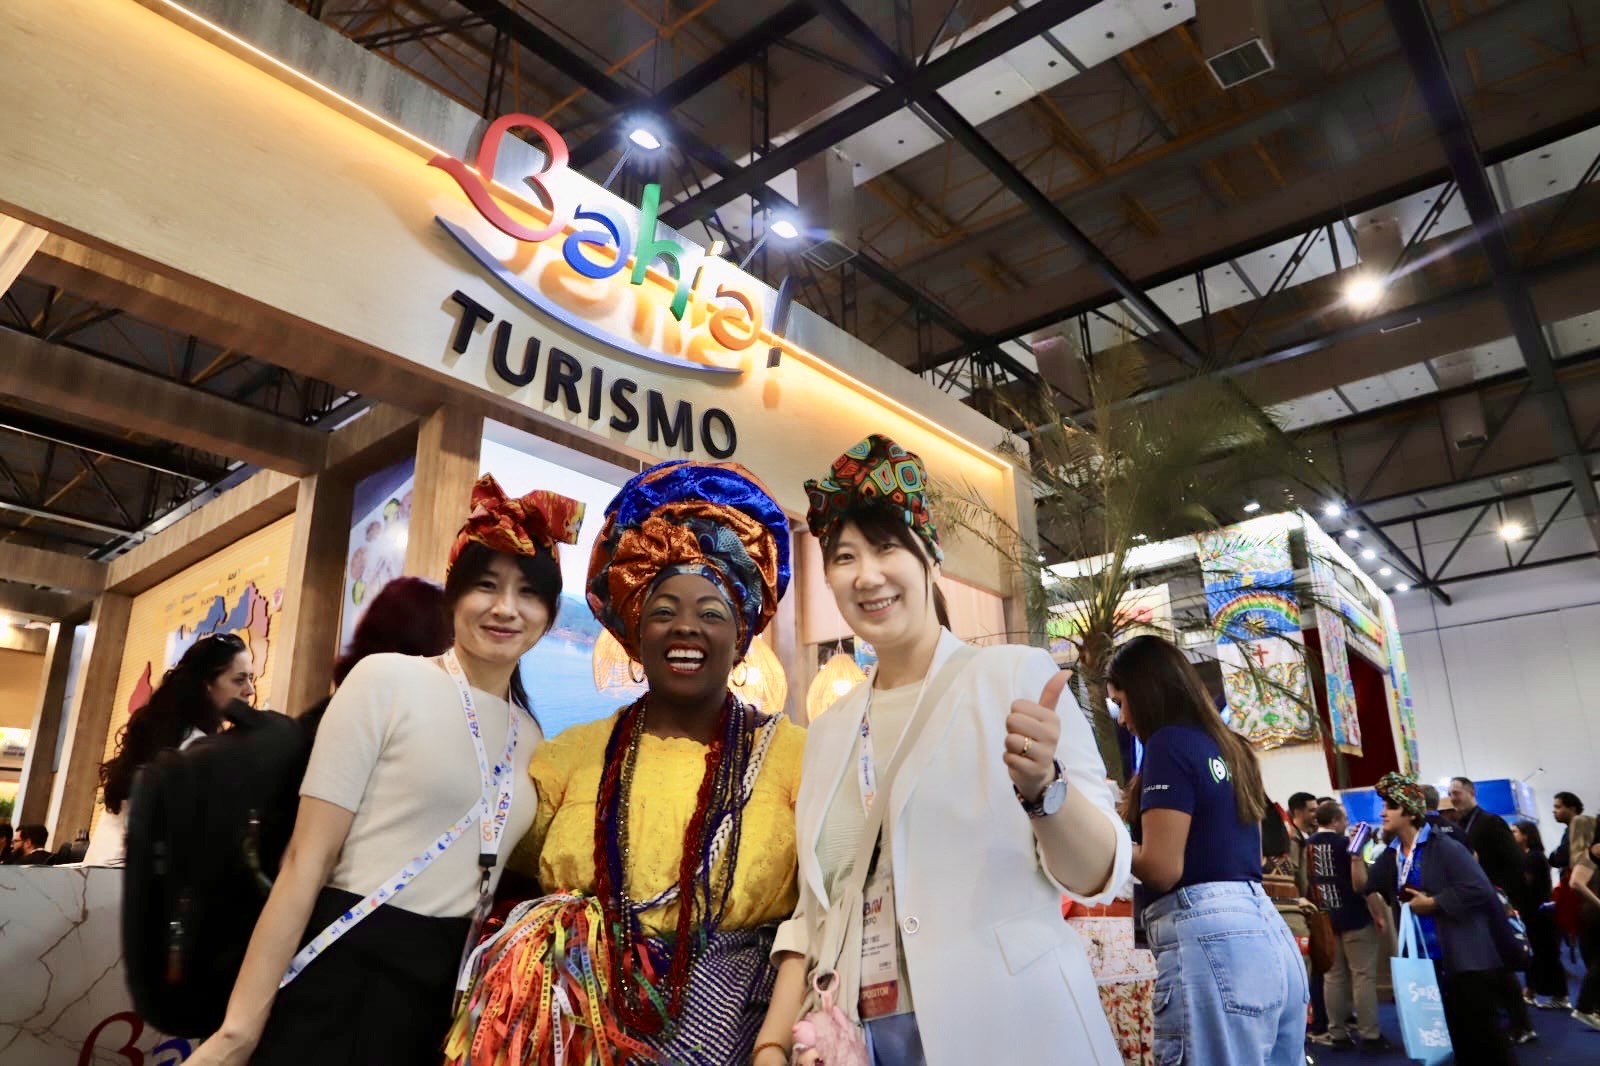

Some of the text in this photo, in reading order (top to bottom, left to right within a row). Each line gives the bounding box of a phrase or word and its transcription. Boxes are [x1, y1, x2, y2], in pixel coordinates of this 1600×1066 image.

[427, 113, 792, 368] Bahia!
[452, 290, 738, 459] TURISMO
[482, 819, 493, 841] GOL
[863, 896, 883, 916] BAV
